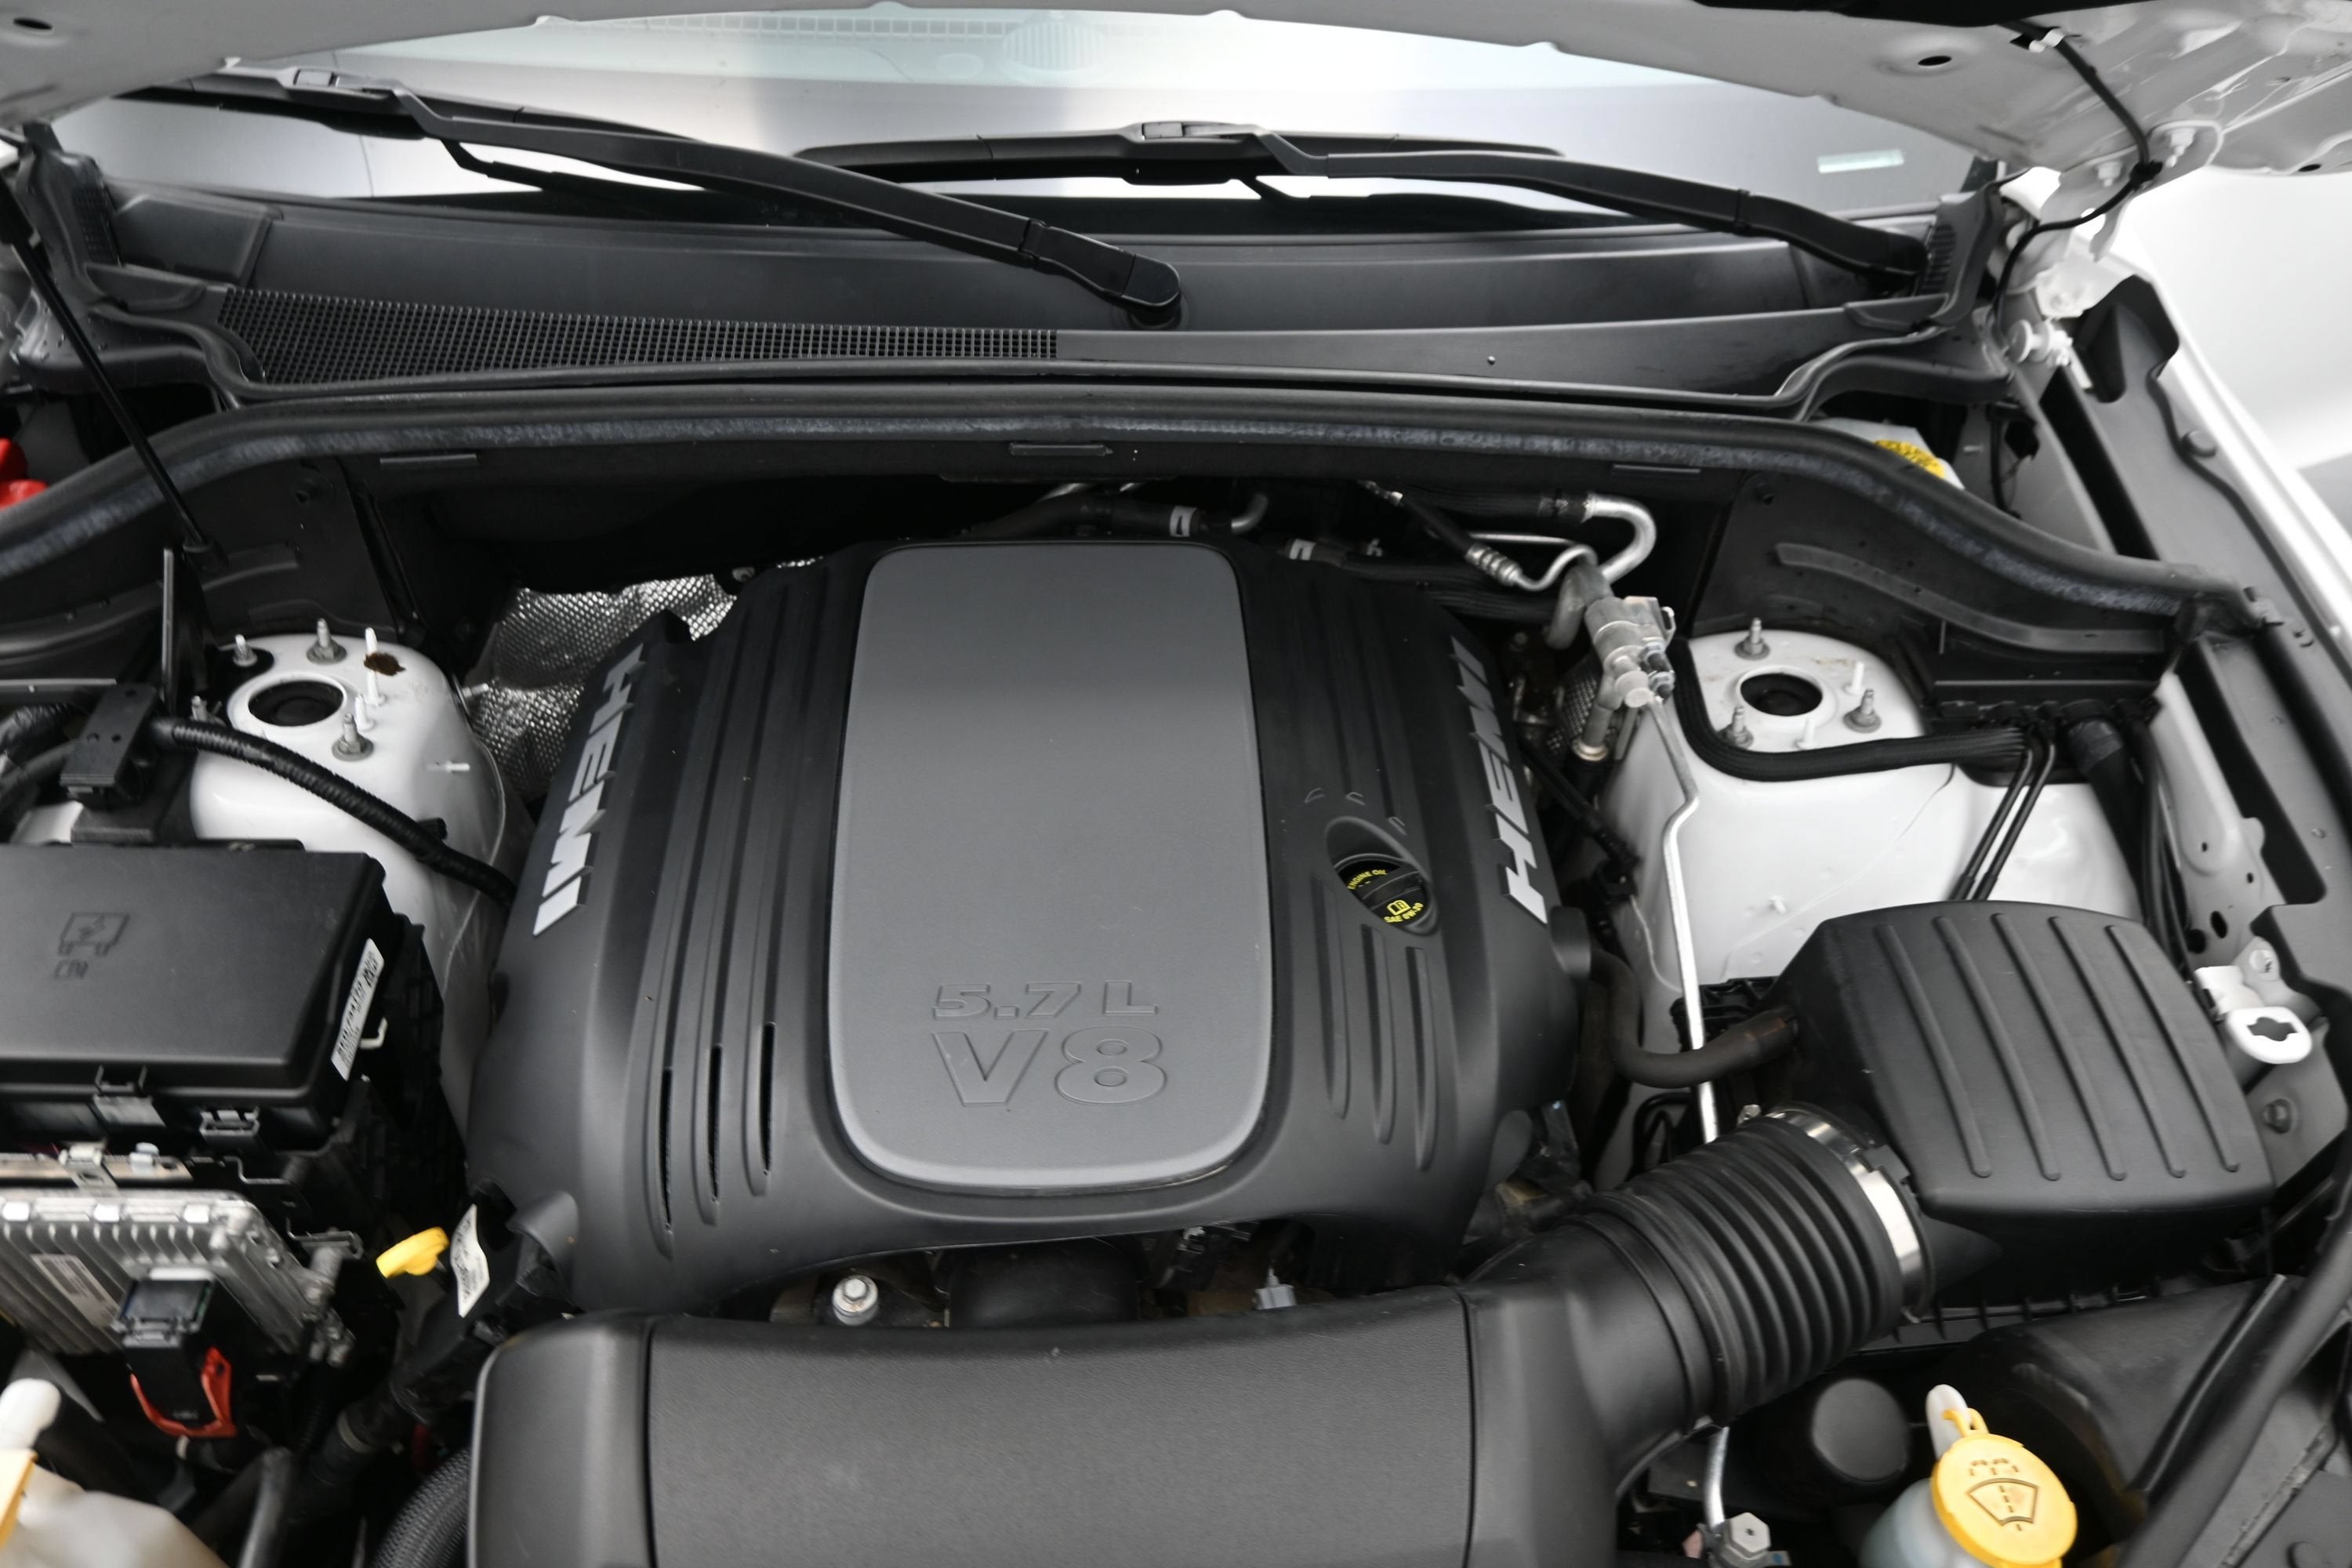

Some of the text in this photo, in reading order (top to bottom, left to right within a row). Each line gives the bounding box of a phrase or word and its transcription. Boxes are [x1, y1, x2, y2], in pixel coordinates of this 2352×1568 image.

[532, 643, 644, 935] HEMI
[1450, 636, 1548, 924] HEMI
[1347, 871, 1373, 890] ENGINE
[931, 1024, 1168, 1107] V8
